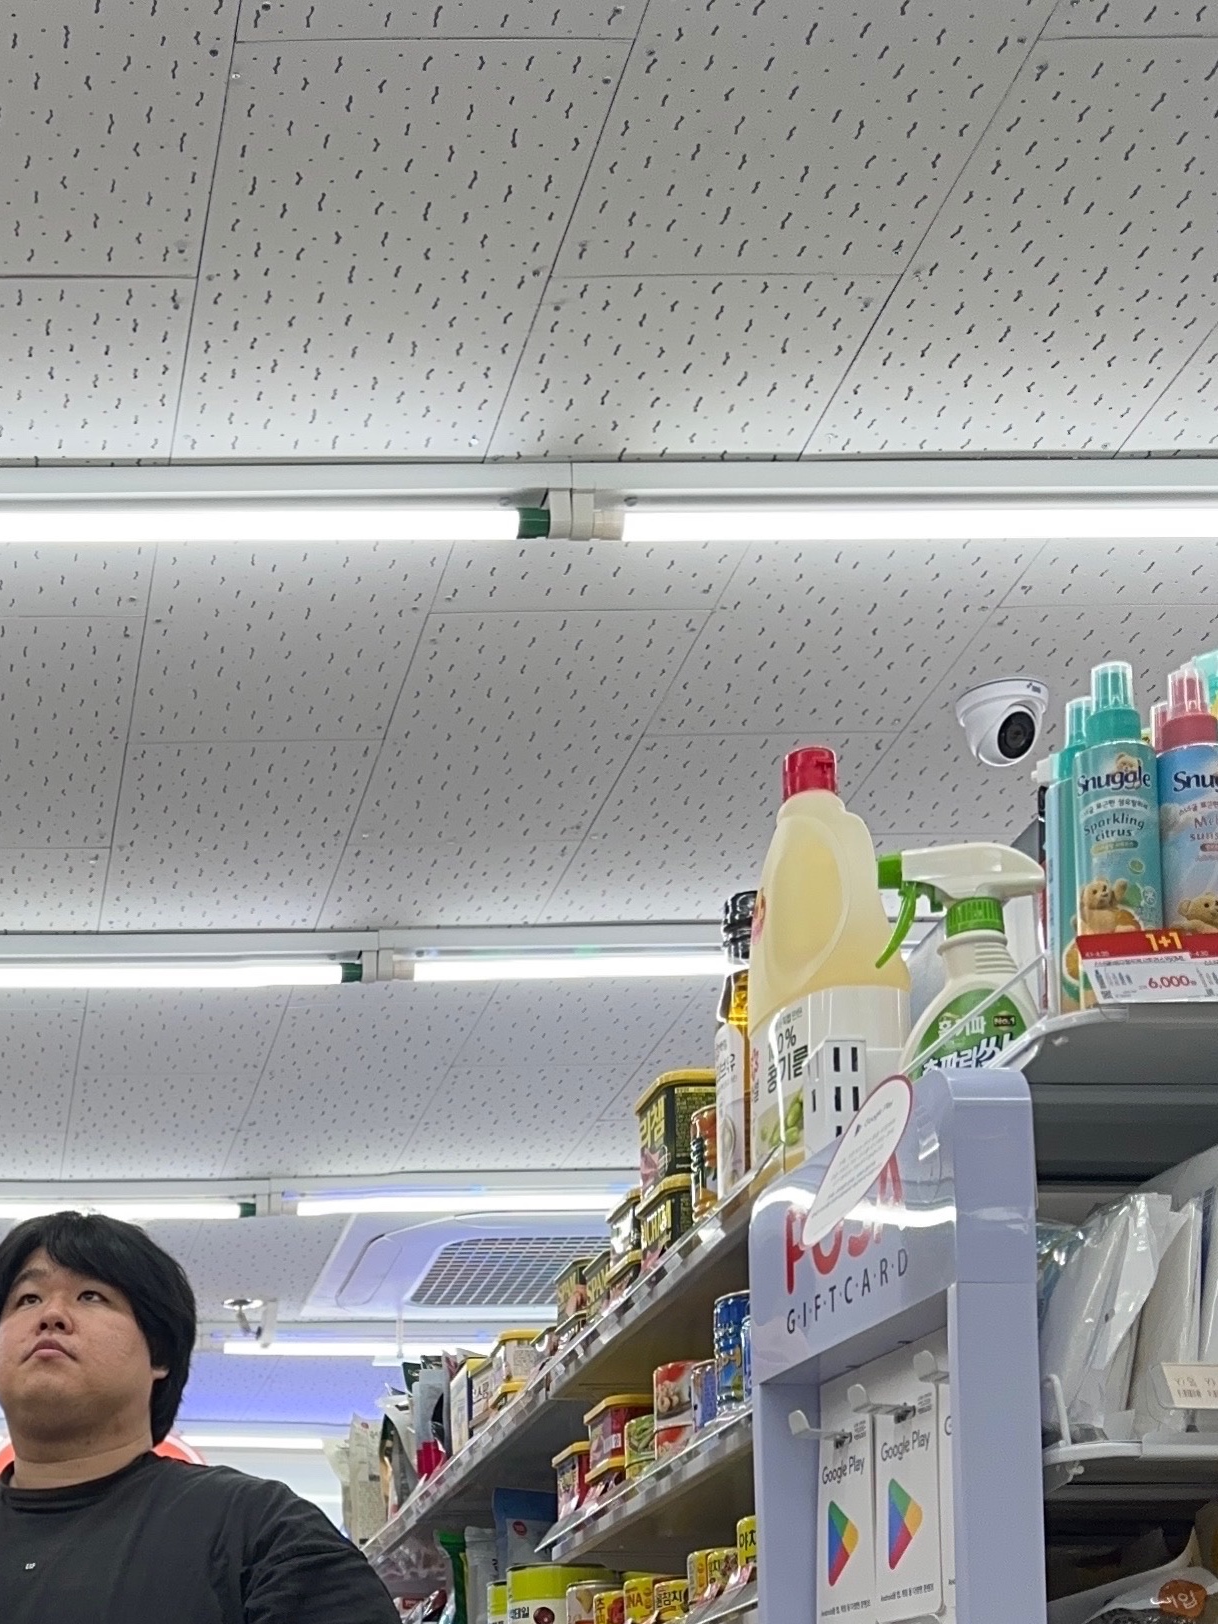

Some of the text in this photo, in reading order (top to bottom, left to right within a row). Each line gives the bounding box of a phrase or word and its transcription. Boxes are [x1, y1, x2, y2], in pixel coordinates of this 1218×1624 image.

[1077, 760, 1151, 797] Snuggle
[1173, 770, 1218, 792] Snu
[1083, 813, 1145, 836] Sparkling
[1095, 829, 1132, 842] citrus
[1190, 833, 1218, 843] suns
[1145, 931, 1182, 952] 1+1
[640, 1096, 666, 1147] 리챔
[881, 1429, 931, 1461] Google Play
[822, 1455, 865, 1485] Google Play
